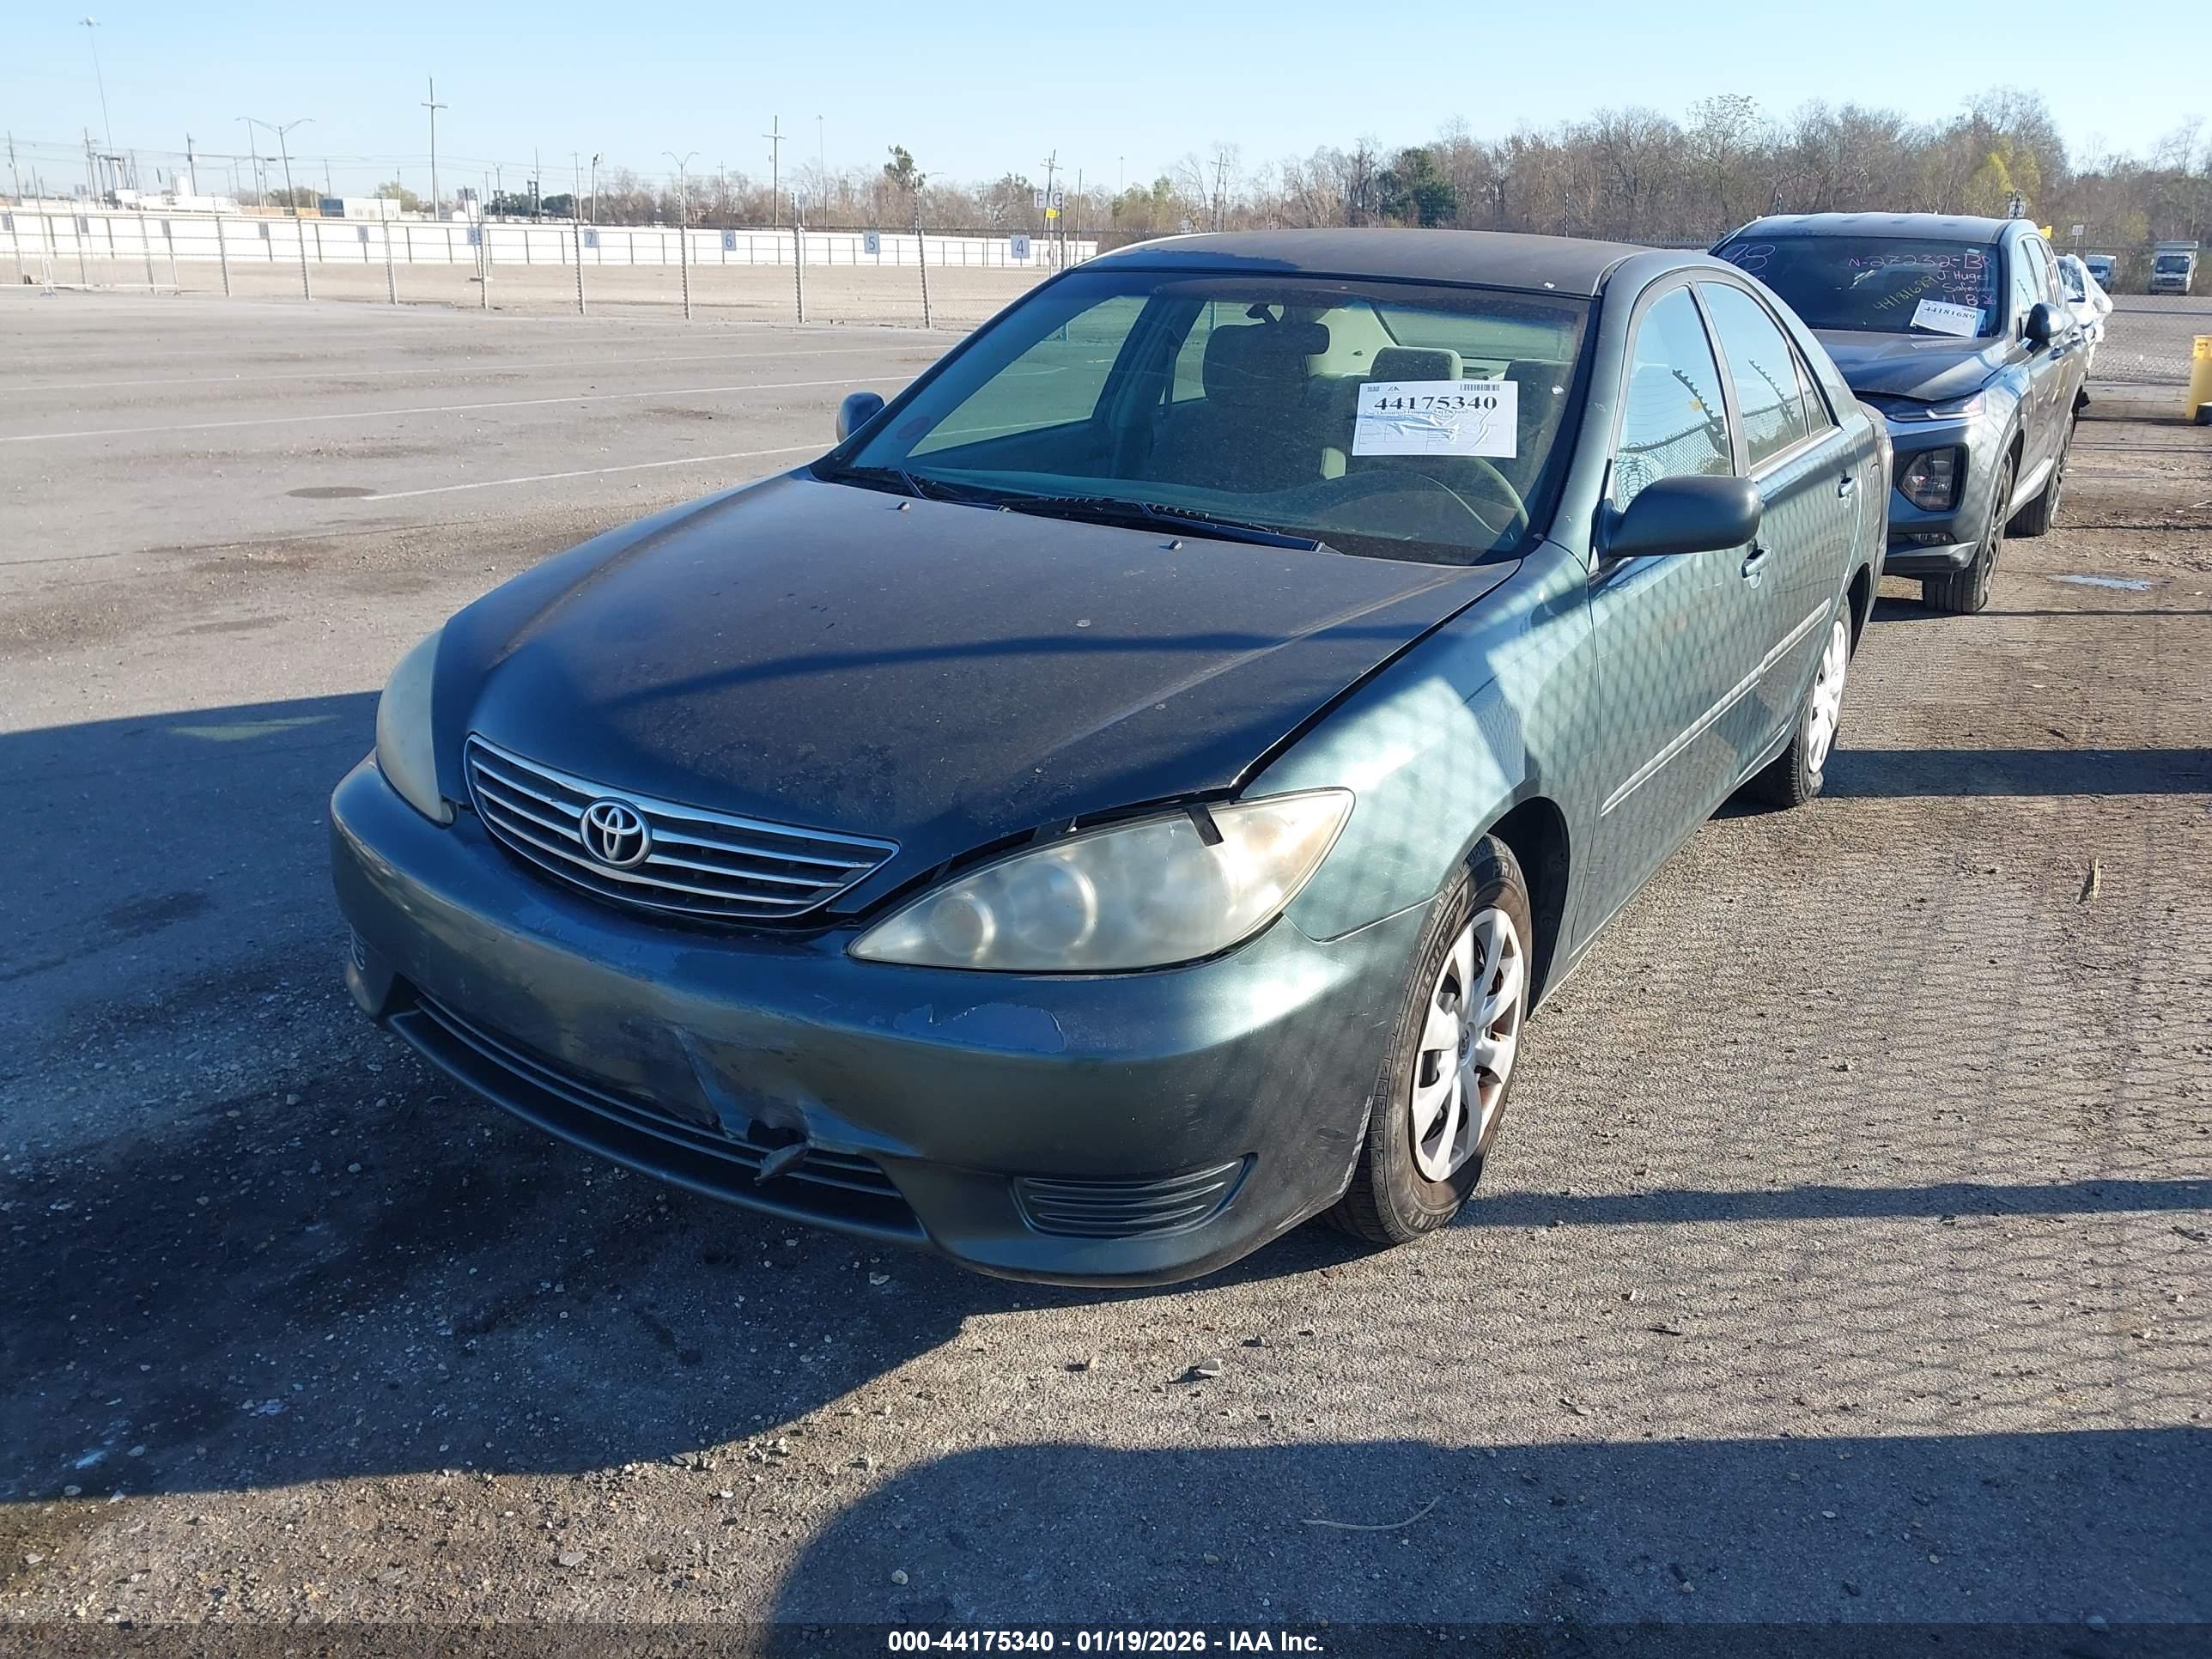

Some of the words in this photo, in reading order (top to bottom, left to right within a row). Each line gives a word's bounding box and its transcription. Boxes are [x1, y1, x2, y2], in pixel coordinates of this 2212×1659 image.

[1036, 192, 1043, 207] F
[725, 234, 733, 248] 6
[868, 235, 876, 251] 5
[1016, 240, 1024, 255] 4
[1923, 306, 1976, 320] 44181689
[1373, 395, 1498, 410] 44175340
